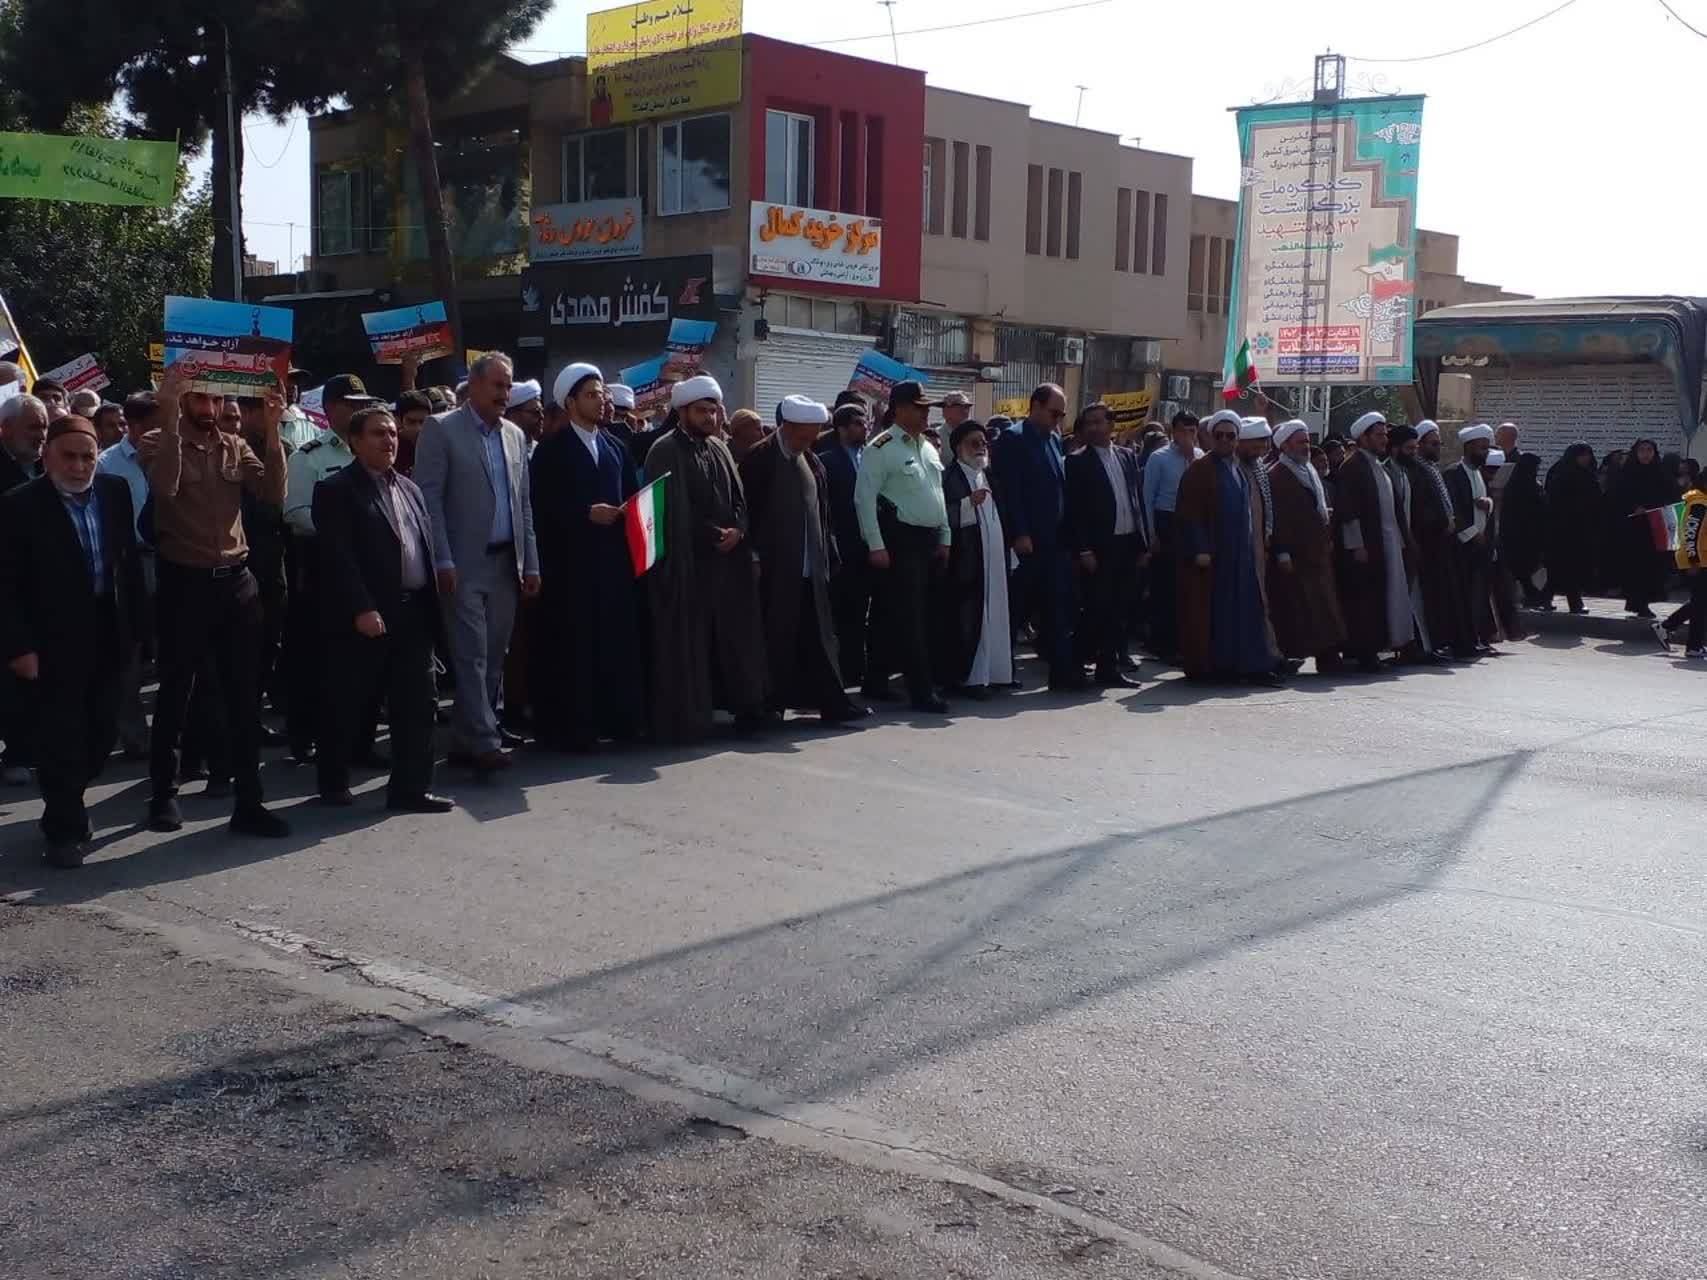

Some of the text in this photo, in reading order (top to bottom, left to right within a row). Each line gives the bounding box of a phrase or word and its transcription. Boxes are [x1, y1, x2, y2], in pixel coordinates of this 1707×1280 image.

[1259, 179, 1361, 198] کنگره ملی
[1259, 197, 1360, 214] بزرگداشت
[760, 206, 878, 255] مرکز خرید کمال
[1257, 221, 1312, 239] شهید
[550, 275, 669, 327] کفش مهدی
[186, 335, 219, 349] خواهد
[221, 338, 240, 350] آزاد
[179, 350, 266, 378] فلسطین
